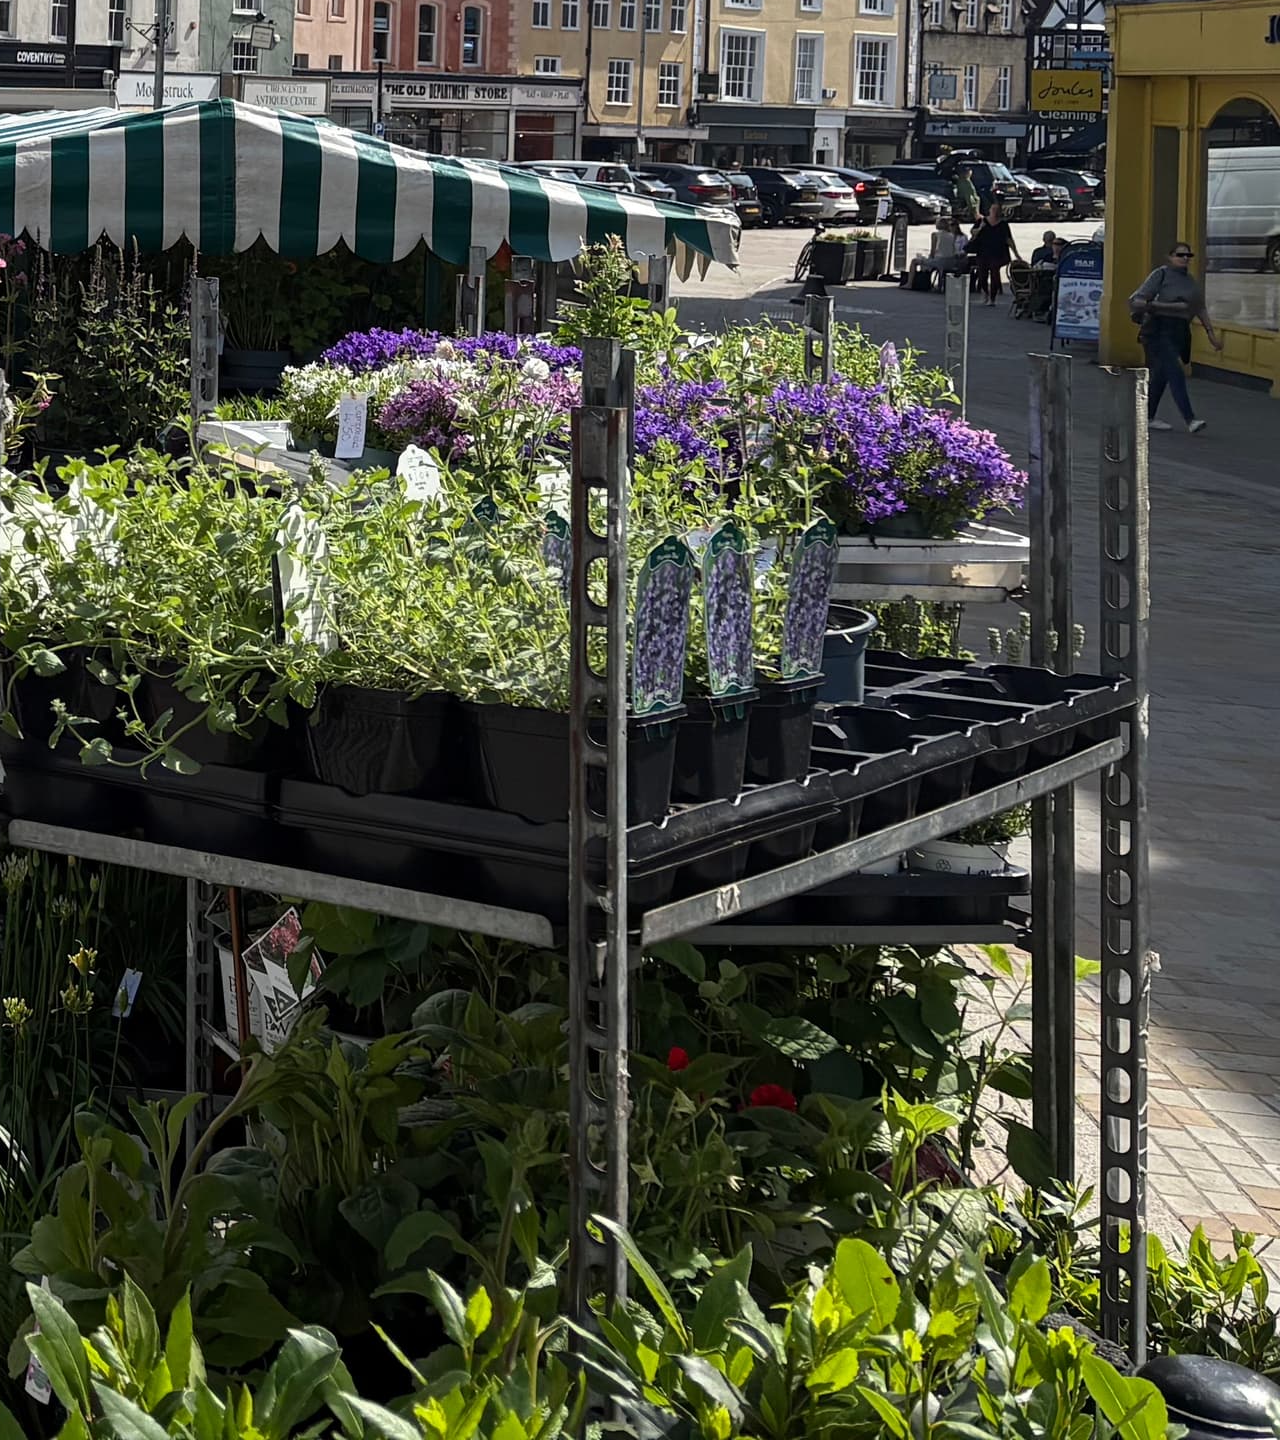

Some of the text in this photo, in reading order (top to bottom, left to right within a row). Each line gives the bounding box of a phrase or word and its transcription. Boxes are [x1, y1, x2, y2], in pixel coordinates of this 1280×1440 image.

[16, 50, 53, 64] COVENTRY
[385, 83, 508, 100] THE OLD DEPARTMENT STORE
[254, 95, 318, 107] ANTIQUES CENTRE
[375, 123, 383, 134] P
